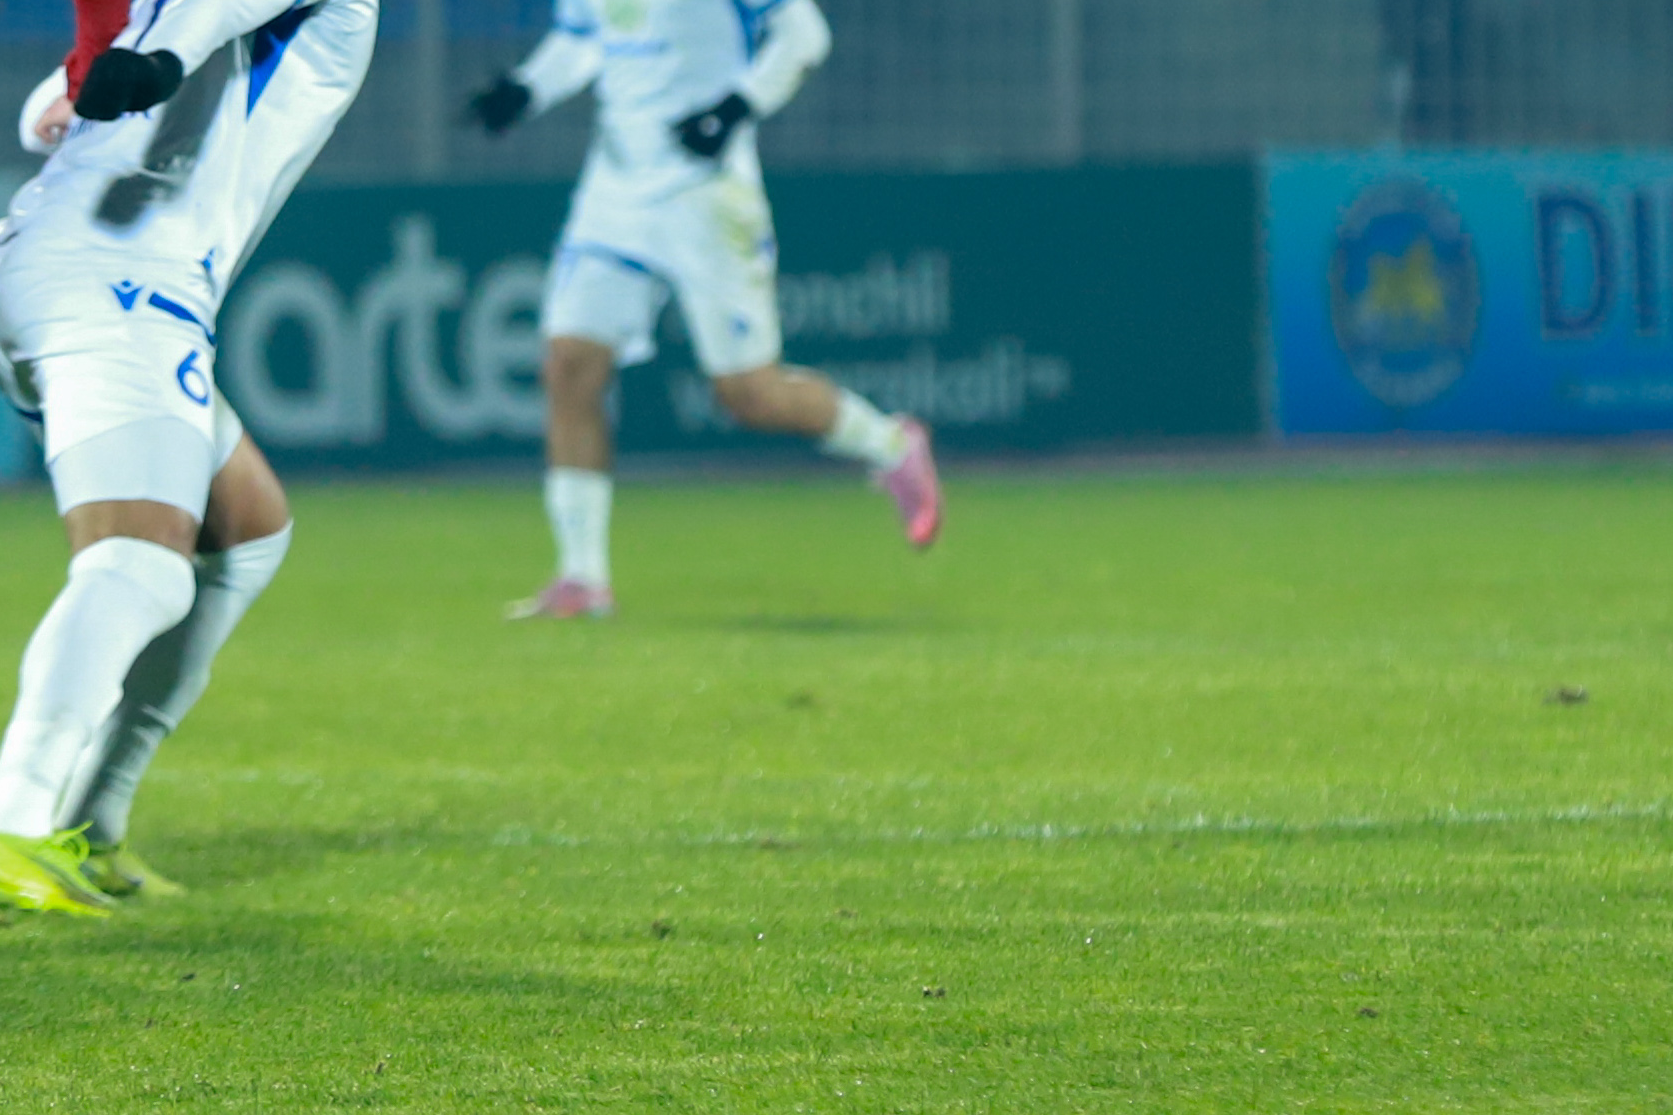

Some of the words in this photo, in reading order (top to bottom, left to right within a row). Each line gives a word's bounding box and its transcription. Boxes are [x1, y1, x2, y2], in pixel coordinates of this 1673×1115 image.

[229, 214, 617, 444] arte
[1535, 190, 1673, 338] DI
[175, 350, 210, 407] 6
